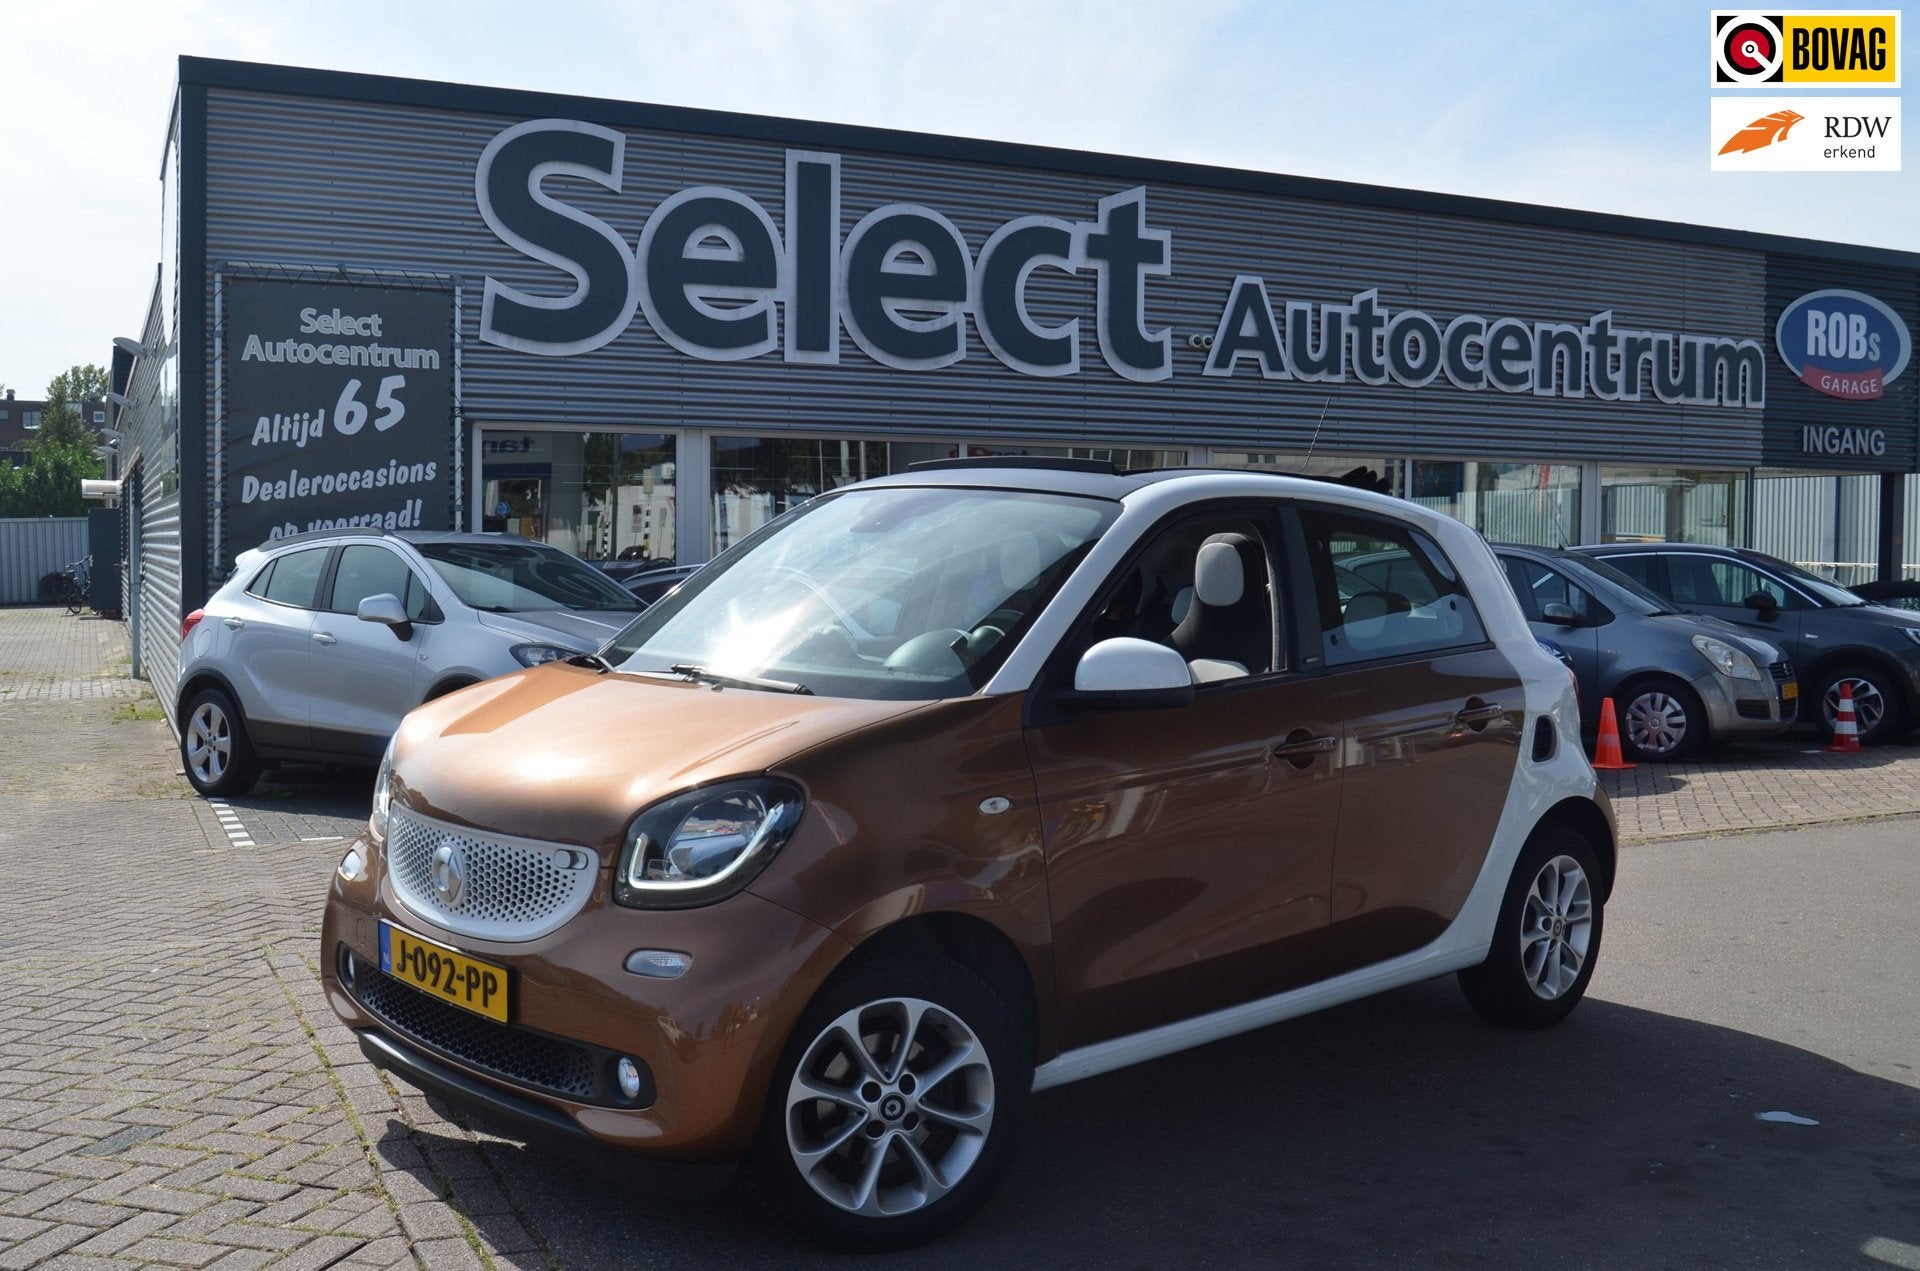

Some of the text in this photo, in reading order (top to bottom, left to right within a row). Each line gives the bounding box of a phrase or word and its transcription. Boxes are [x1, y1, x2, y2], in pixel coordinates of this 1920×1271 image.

[475, 118, 1766, 409] Select Autocentrum
[300, 307, 382, 337] Select
[1806, 309, 1881, 362] ROBs
[241, 334, 440, 370] Autocentrum
[1820, 375, 1878, 394] GARAGE
[251, 374, 406, 448] Altijd 65
[1802, 425, 1886, 456] INGANG
[241, 459, 437, 504] Dealeroccasions
[396, 939, 498, 1008] J-092-PP
